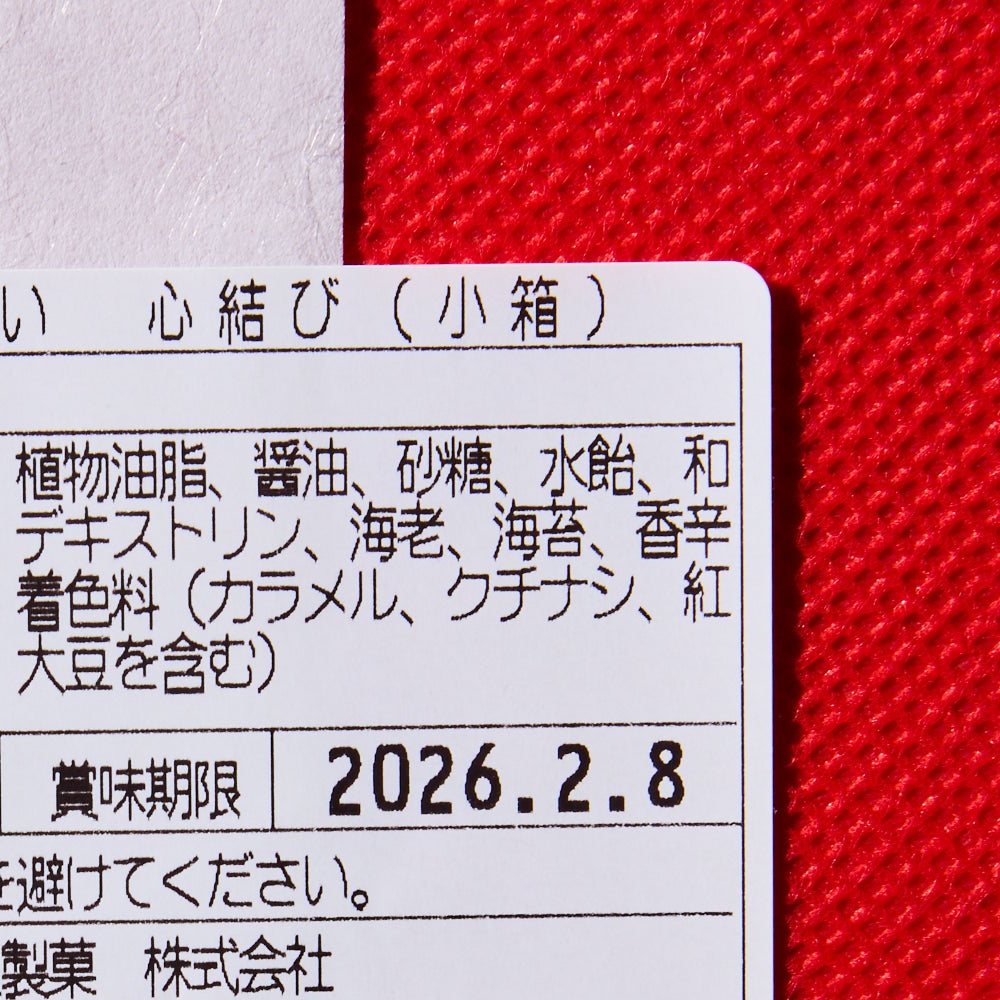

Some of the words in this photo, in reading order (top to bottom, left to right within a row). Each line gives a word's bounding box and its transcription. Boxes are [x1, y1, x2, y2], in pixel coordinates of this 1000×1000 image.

[149, 275, 606, 343] 心結び（小箱）
[51, 758, 240, 821] 賞味期限
[329, 741, 684, 816] 2026.2.8
[144, 934, 334, 997] 株式会社
